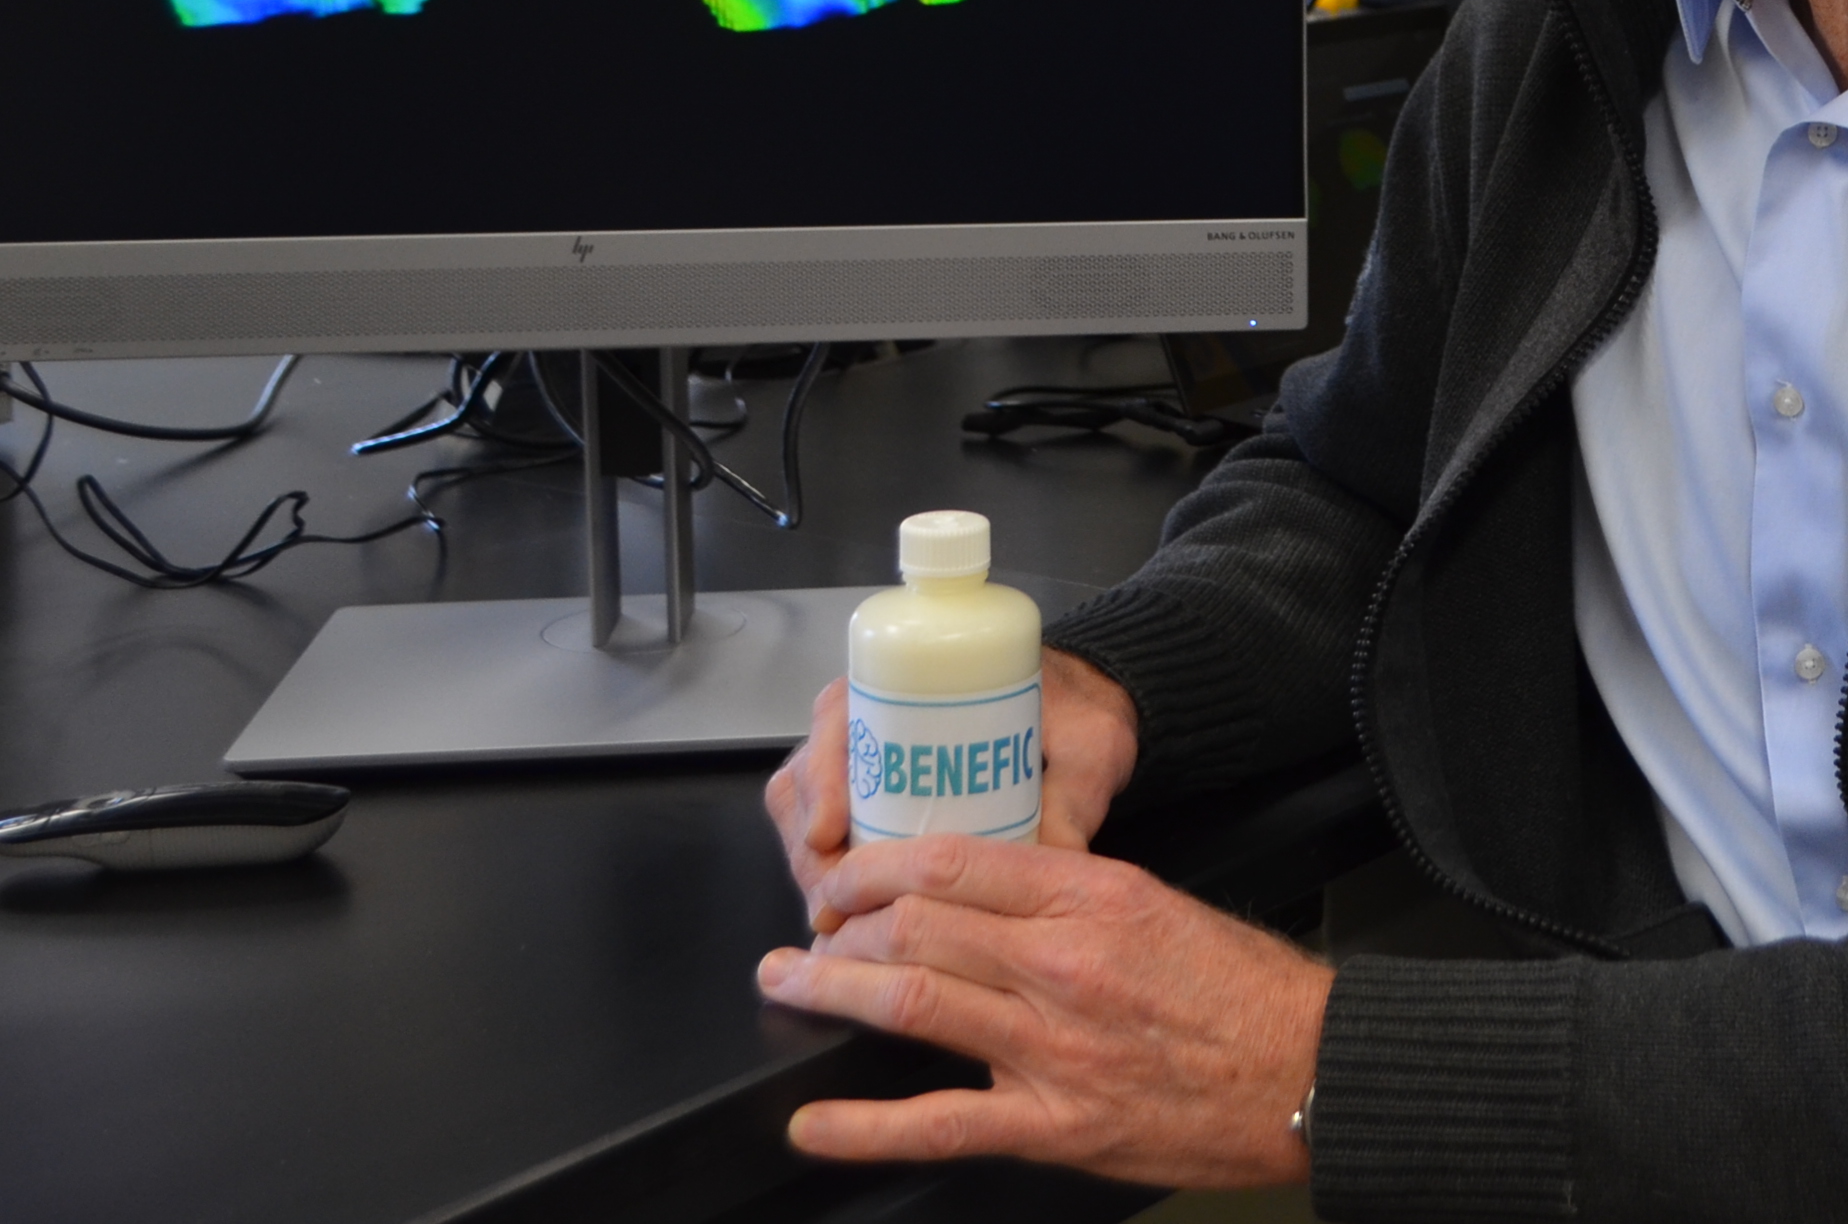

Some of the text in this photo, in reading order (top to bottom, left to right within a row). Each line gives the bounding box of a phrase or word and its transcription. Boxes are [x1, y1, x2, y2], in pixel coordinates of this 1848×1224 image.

[1207, 231, 1295, 241] BANG & OLUFSEN
[884, 726, 1034, 797] BENEFIC
